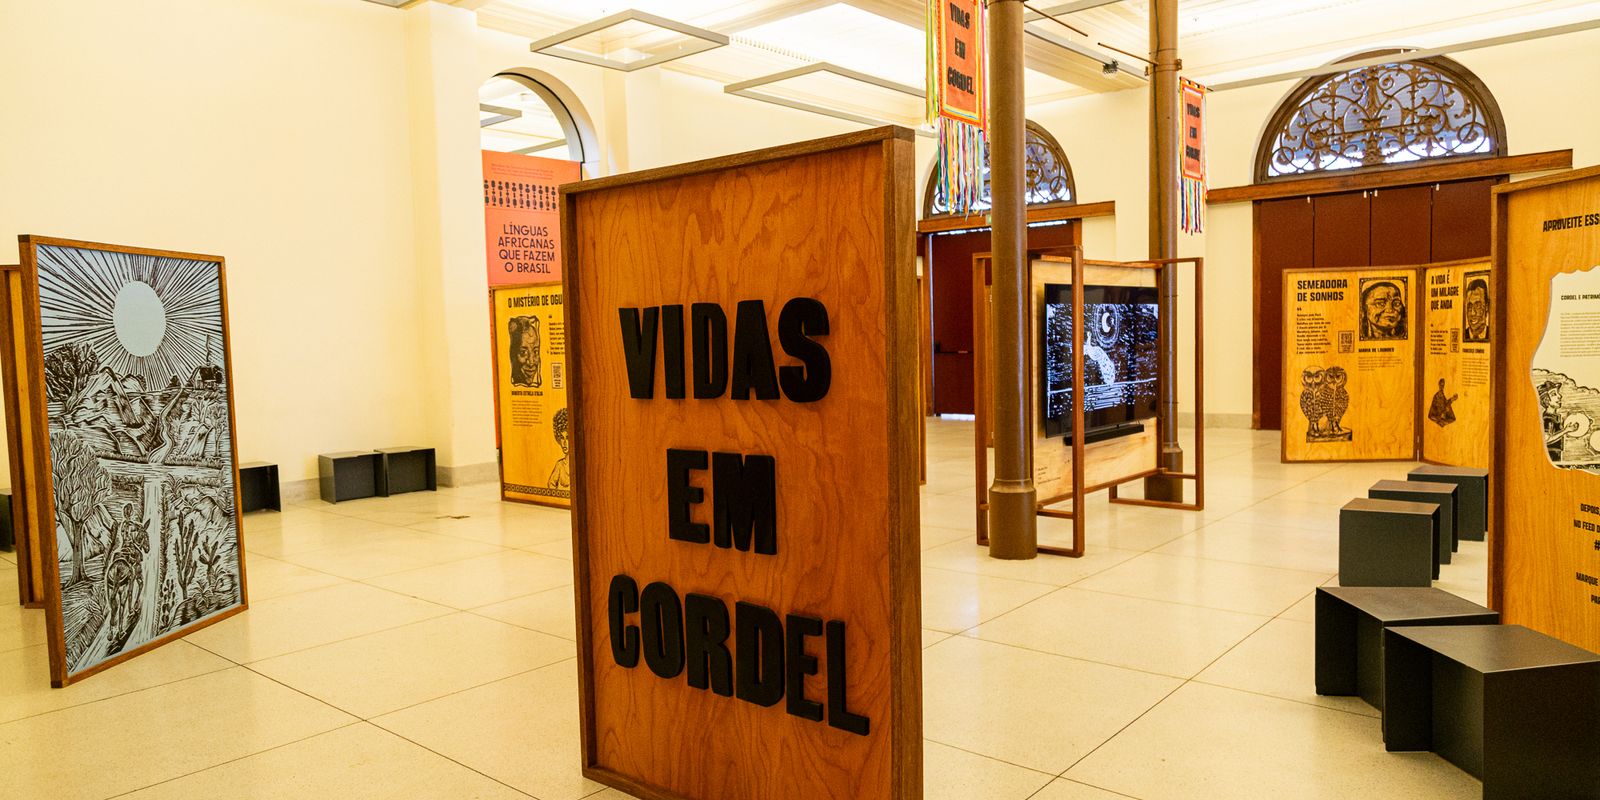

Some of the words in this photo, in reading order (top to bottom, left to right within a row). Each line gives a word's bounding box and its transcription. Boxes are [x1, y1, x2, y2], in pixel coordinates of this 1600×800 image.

[950, 2, 970, 30] VIDAS
[955, 37, 966, 60] EM
[947, 66, 974, 95] CORDEL
[503, 222, 548, 237] LÍNGUAS
[1543, 216, 1582, 232] APROVEITE
[1585, 213, 1600, 226] ESS
[498, 237, 555, 249] AFRICANAS
[499, 249, 520, 261] QUE
[523, 251, 555, 261] FAZEM
[504, 262, 514, 273] O
[517, 262, 551, 274] BRASIL
[1297, 279, 1348, 290] SEMEADORA
[1431, 275, 1435, 285] A
[1436, 274, 1446, 285] VIDA
[1297, 293, 1308, 302] DE
[1310, 291, 1344, 301] SONHOS
[1439, 285, 1459, 297] MILAGRE
[513, 294, 540, 308] MISTÉRIO
[541, 295, 549, 306] DE
[1431, 300, 1439, 312] QUE
[1440, 299, 1452, 310] ANDA
[618, 297, 832, 402] VIDAS
[667, 448, 778, 556] EM
[1573, 519, 1582, 529] NO
[1582, 521, 1596, 532] FEED
[1576, 571, 1598, 586] MARQUE
[608, 573, 871, 737] CORDEL
